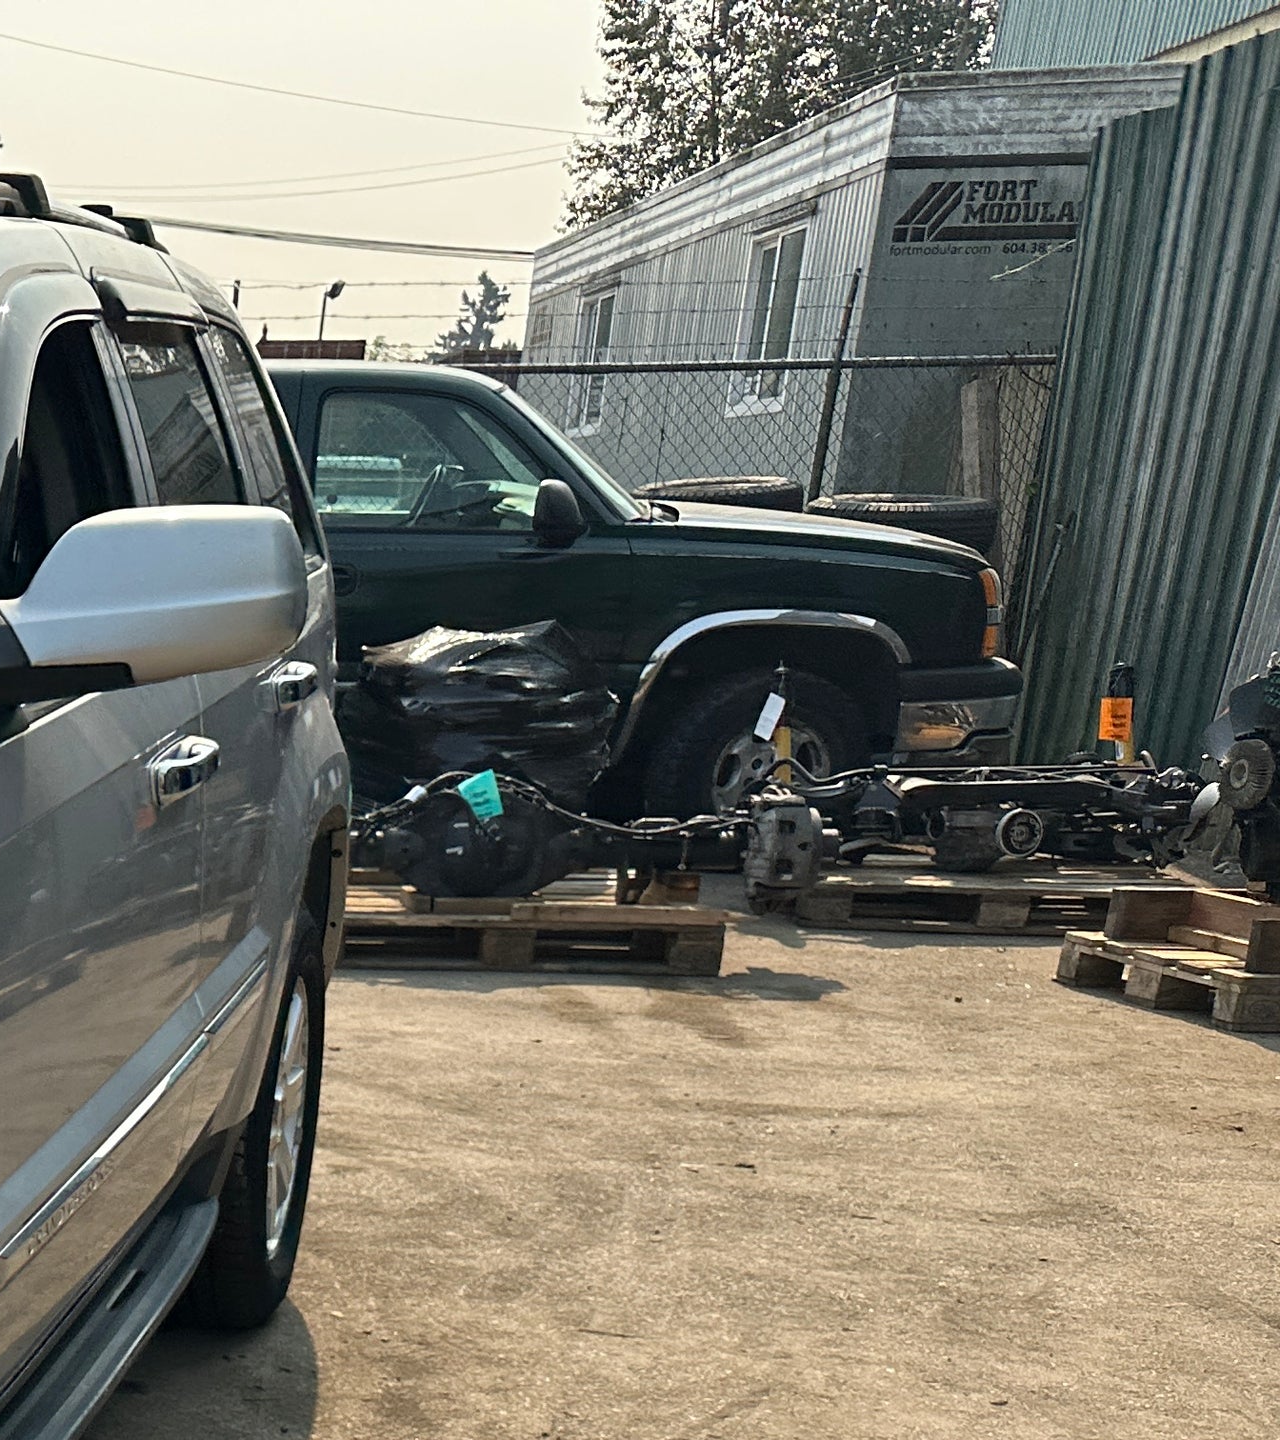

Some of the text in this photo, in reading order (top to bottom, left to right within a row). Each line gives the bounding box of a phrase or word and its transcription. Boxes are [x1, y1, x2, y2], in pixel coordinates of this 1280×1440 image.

[965, 179, 1038, 202] FORT
[961, 200, 1080, 223] MODULA
[889, 243, 991, 257] fortmodular.com
